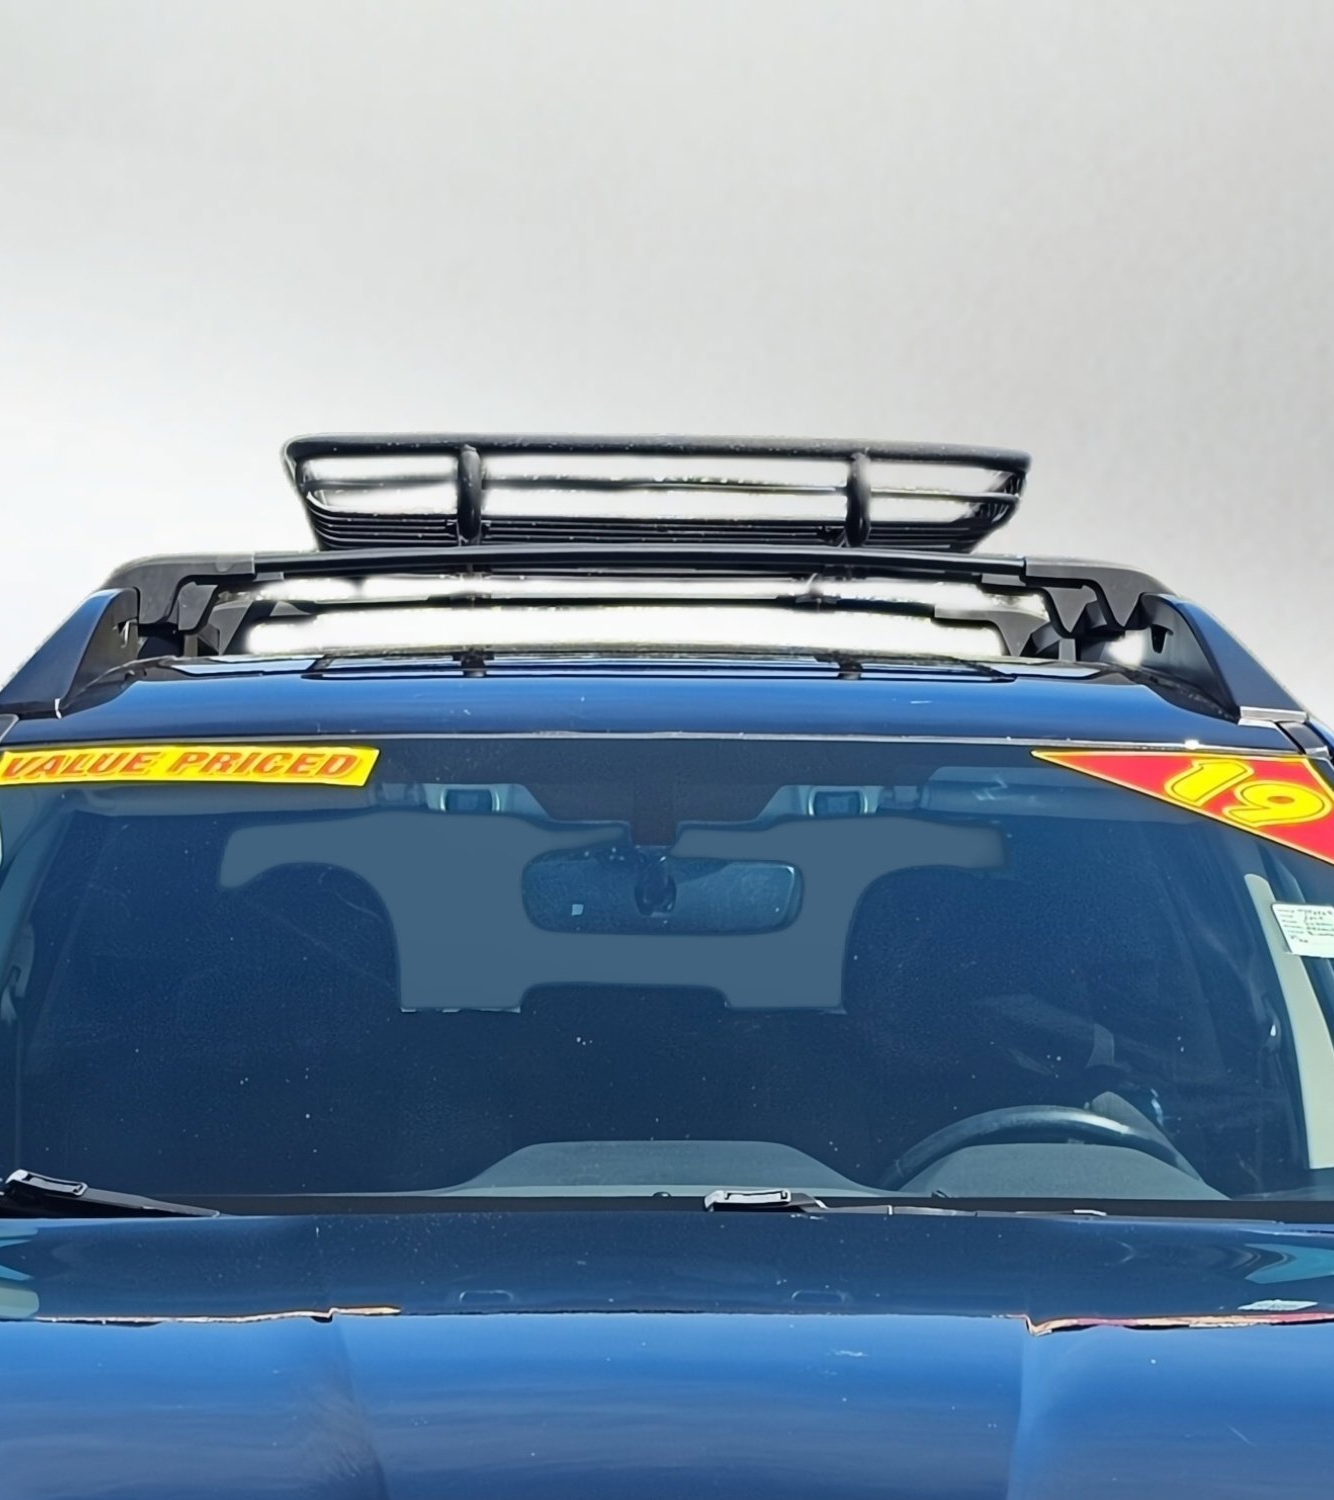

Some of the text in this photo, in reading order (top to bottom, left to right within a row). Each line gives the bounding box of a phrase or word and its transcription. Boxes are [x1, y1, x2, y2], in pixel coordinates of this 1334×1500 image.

[1, 750, 362, 780] VALUE PRICED
[1165, 758, 1332, 826] 19
